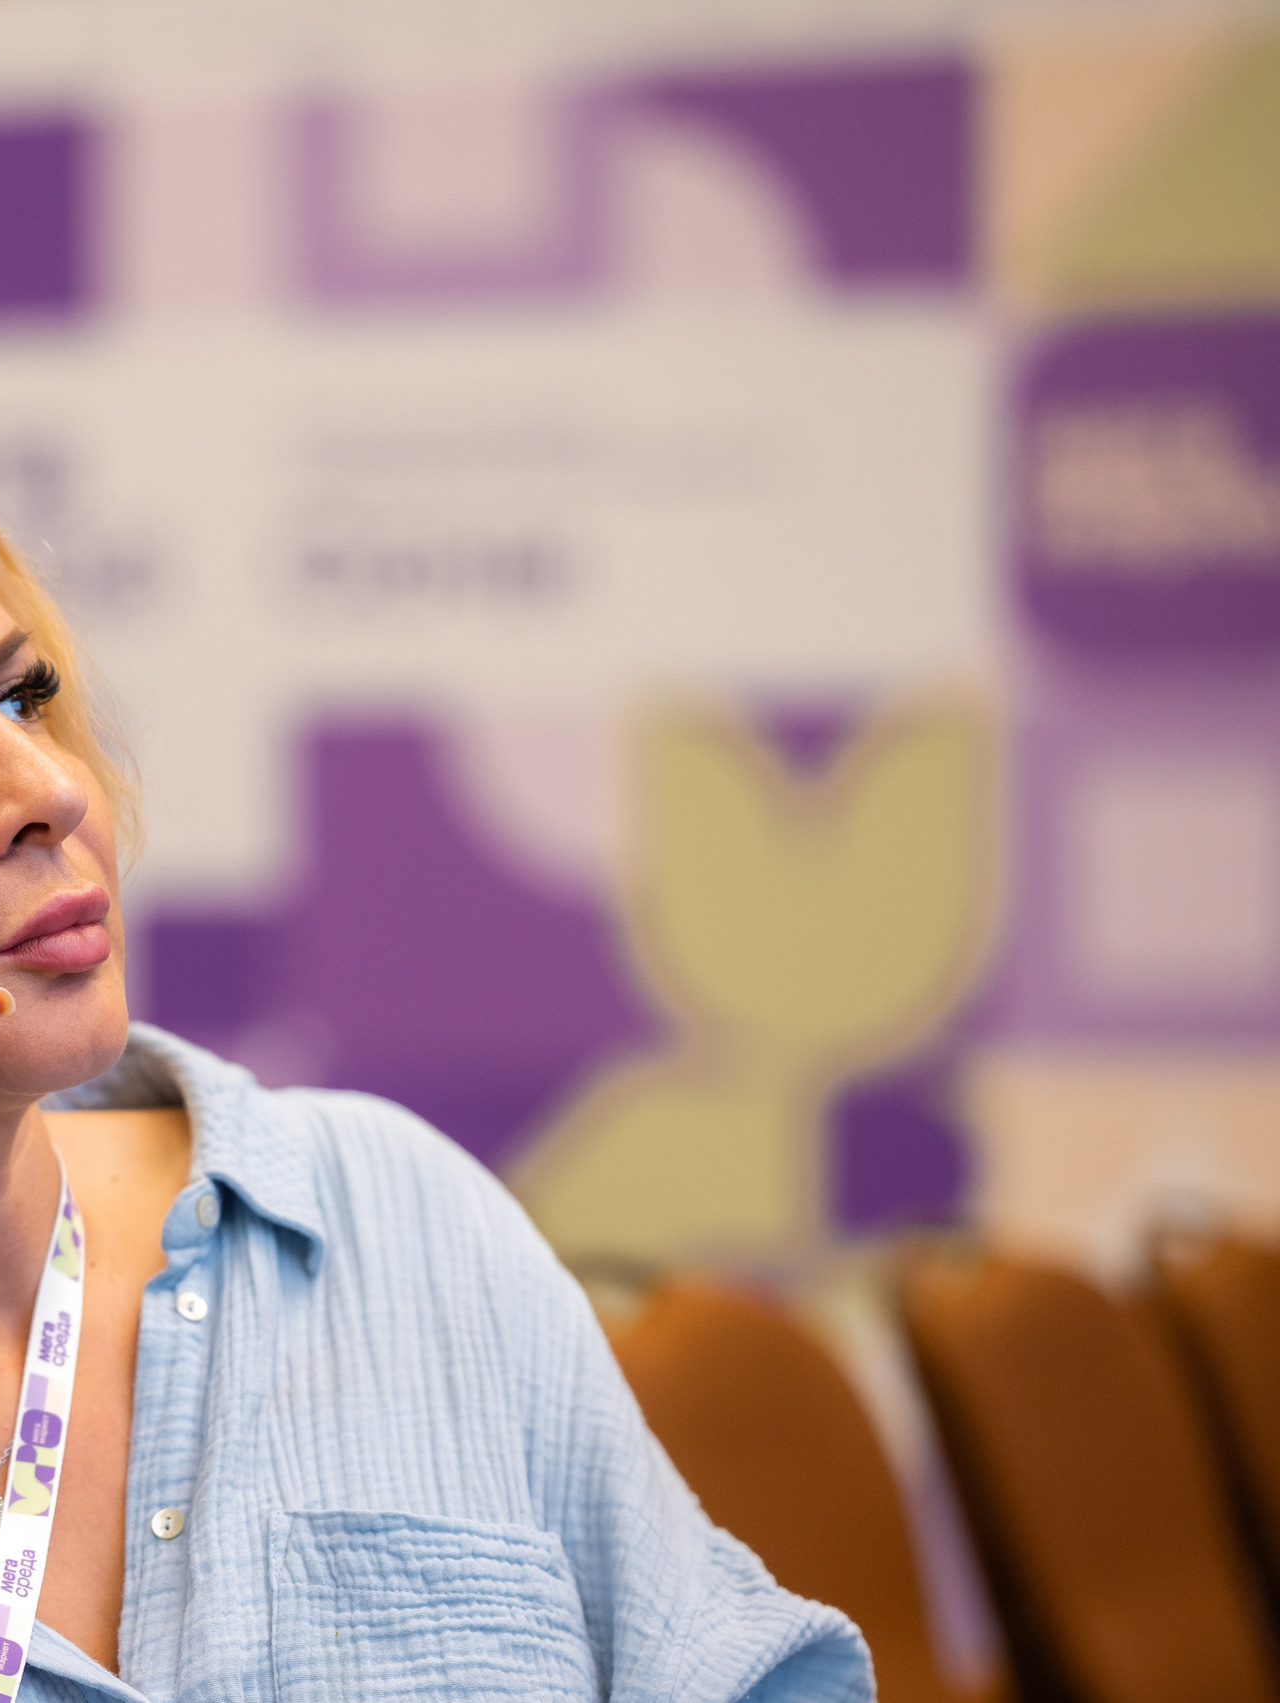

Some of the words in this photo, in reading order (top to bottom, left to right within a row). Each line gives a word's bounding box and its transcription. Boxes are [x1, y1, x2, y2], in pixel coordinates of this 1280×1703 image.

[39, 1321, 55, 1363] мега
[52, 1311, 71, 1367] среда
[1, 1558, 18, 1593] мега
[15, 1548, 36, 1598] среда
